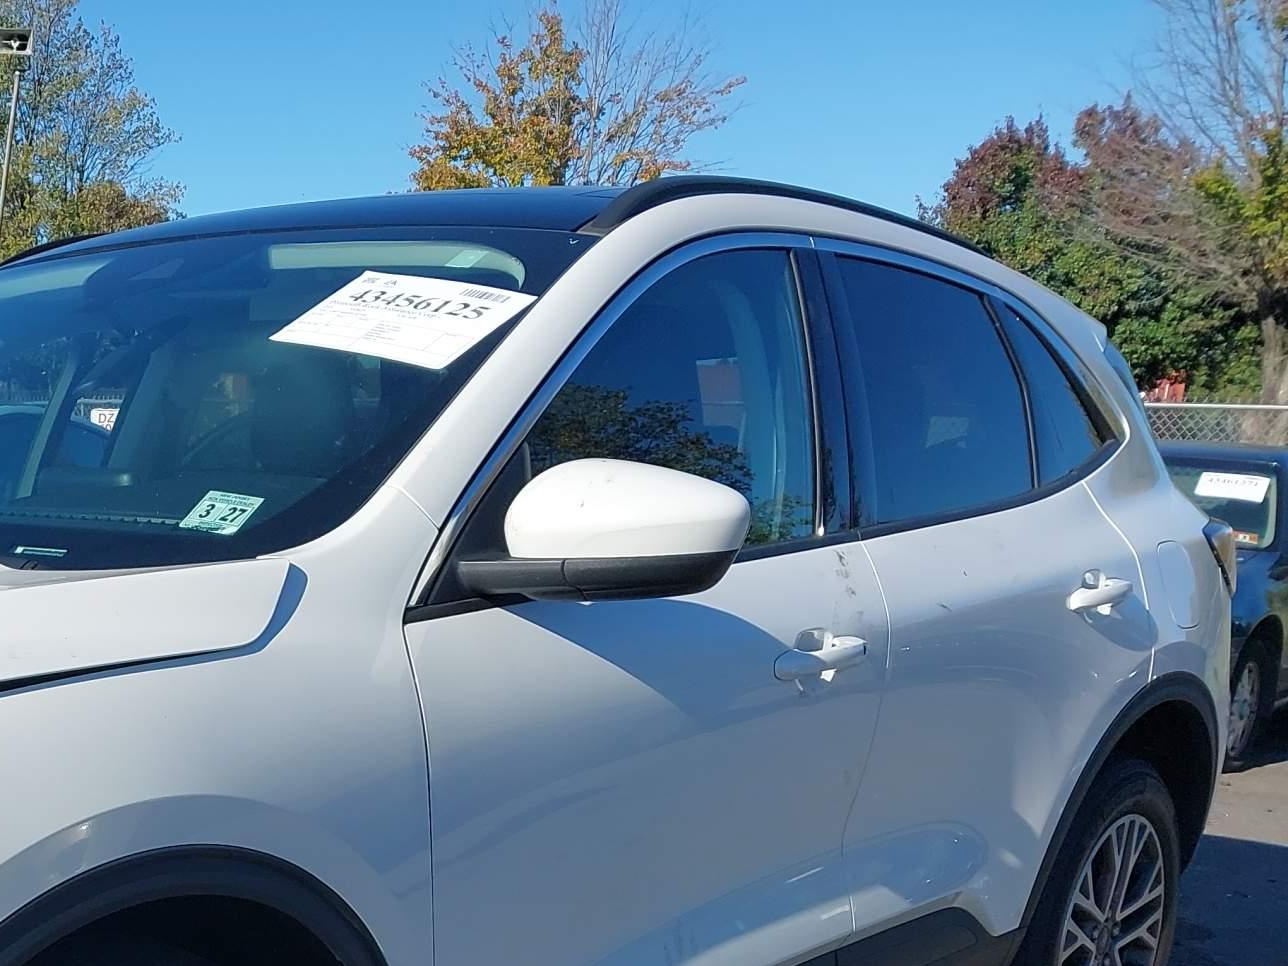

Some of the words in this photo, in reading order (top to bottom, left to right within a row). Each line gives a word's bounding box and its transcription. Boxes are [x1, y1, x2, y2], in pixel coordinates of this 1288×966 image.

[349, 289, 491, 320] 43456125
[98, 413, 115, 424] DZ
[198, 503, 216, 519] 3
[218, 506, 249, 523] 27
